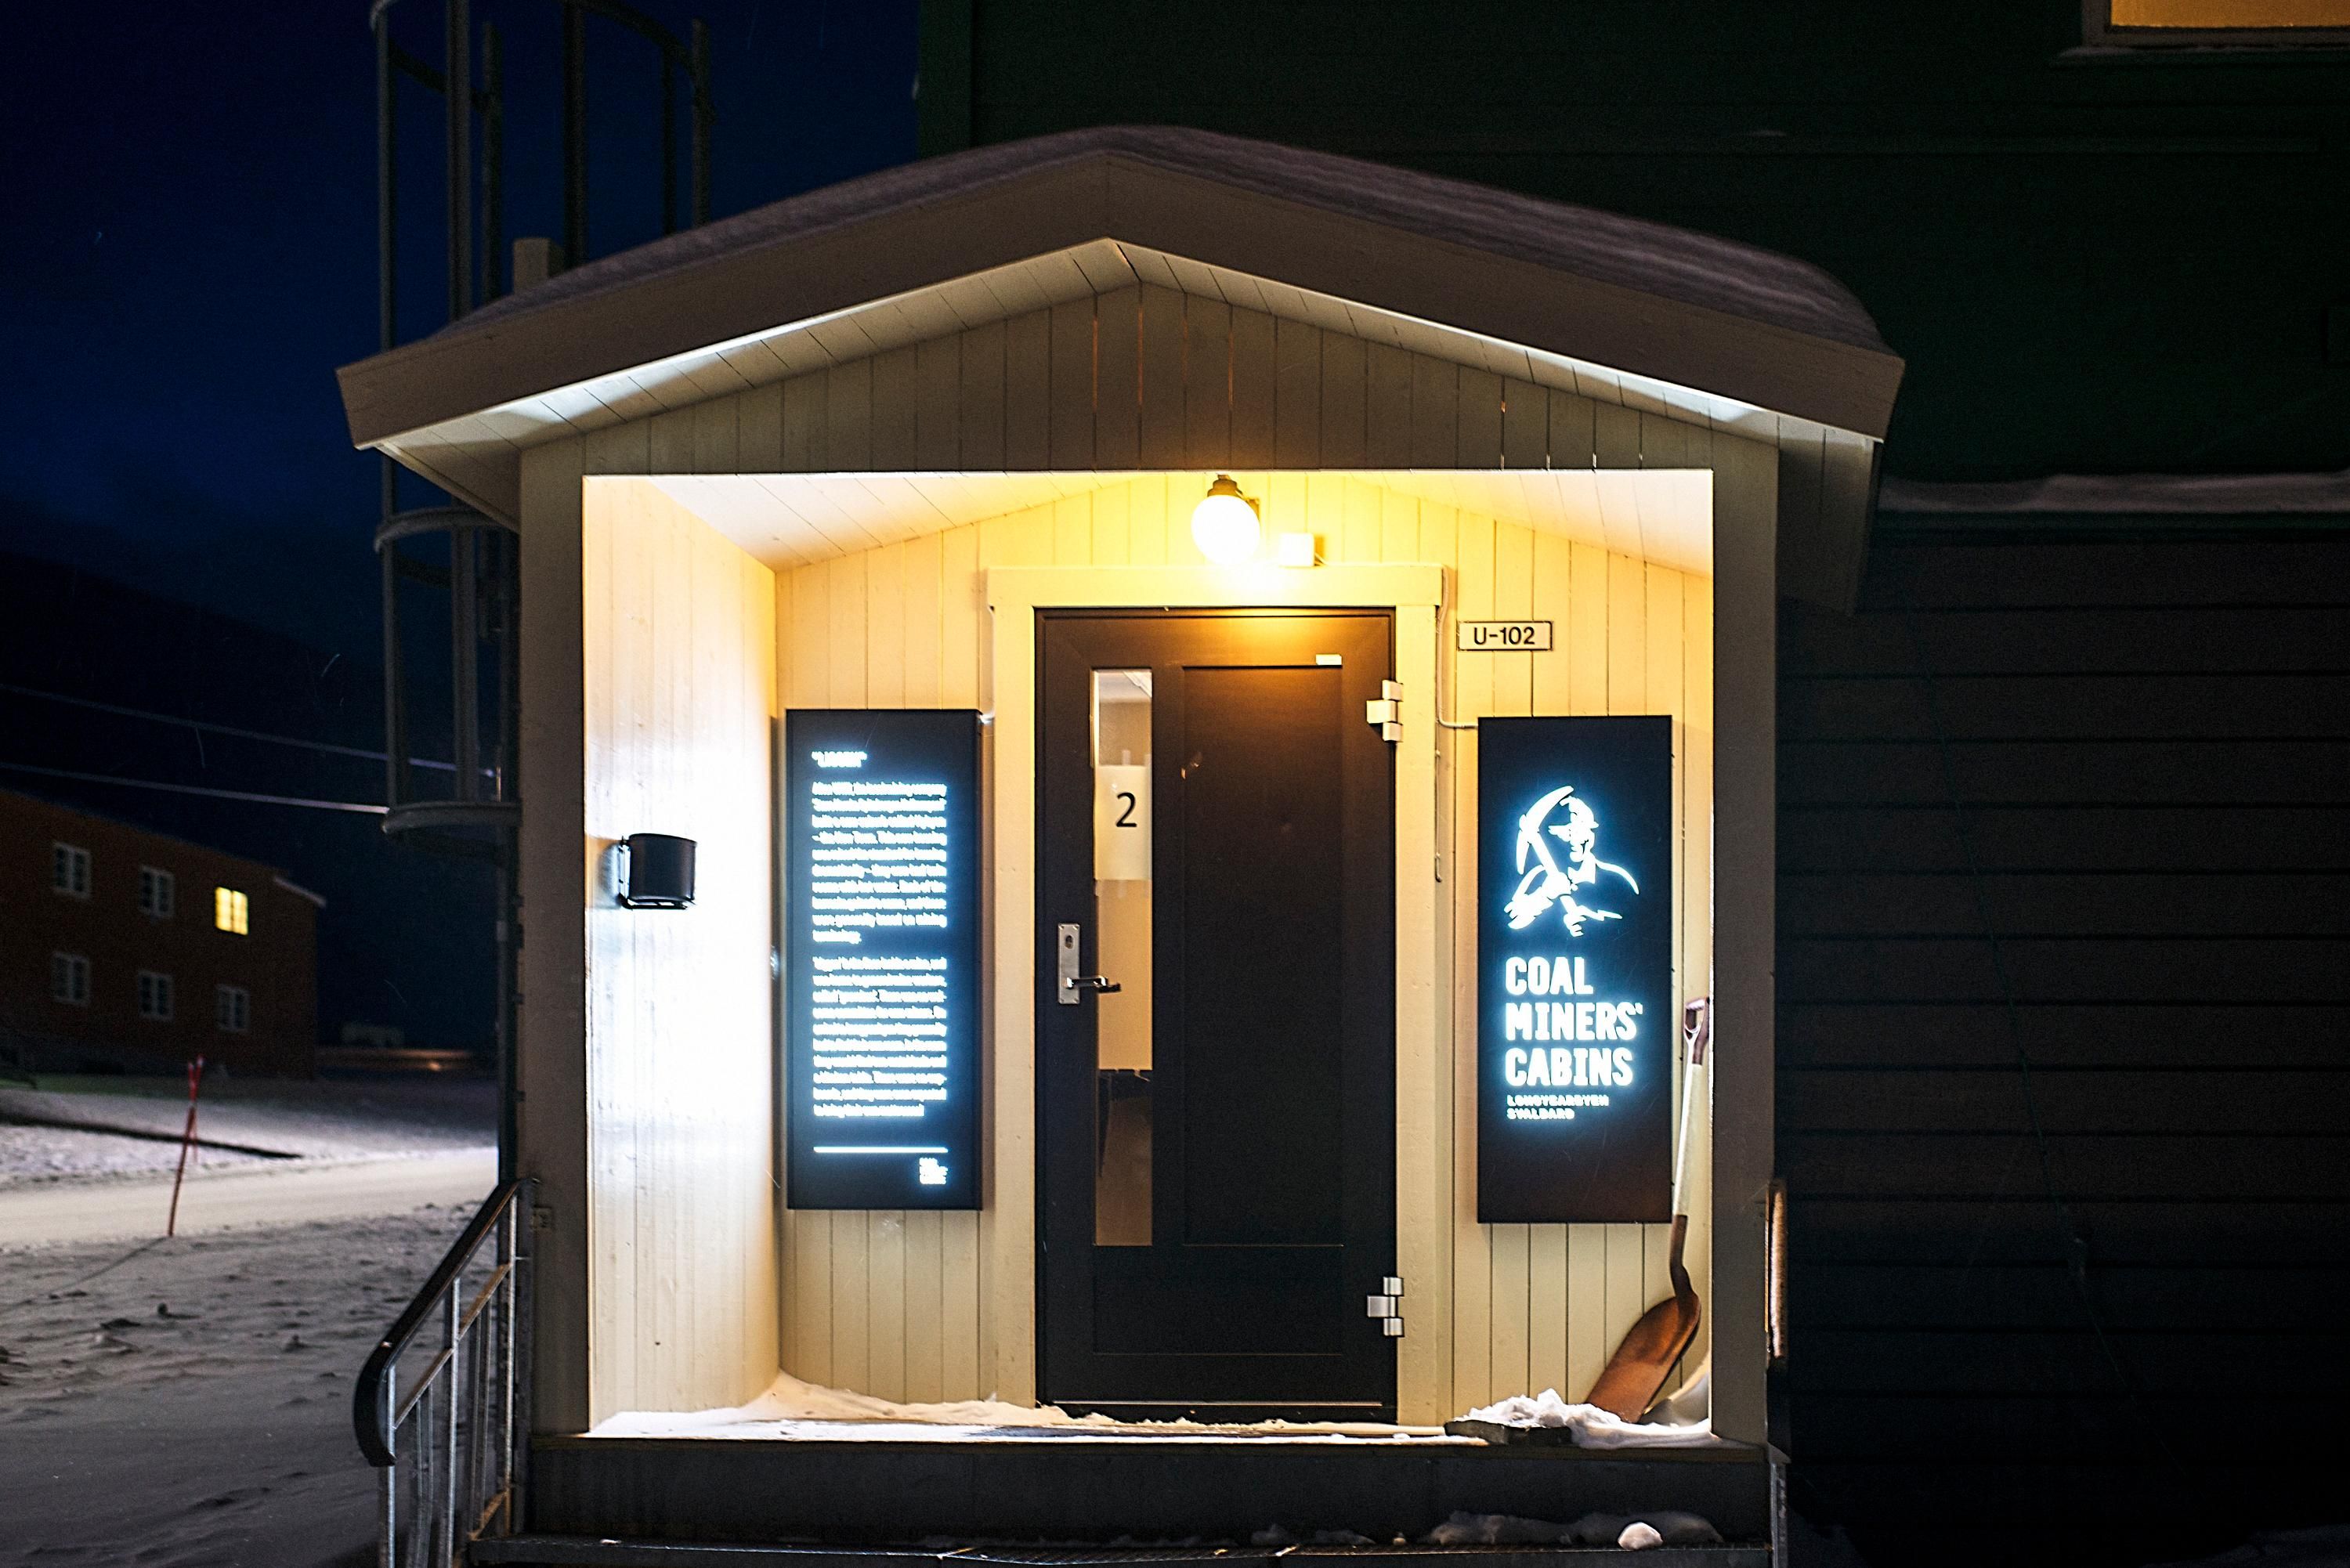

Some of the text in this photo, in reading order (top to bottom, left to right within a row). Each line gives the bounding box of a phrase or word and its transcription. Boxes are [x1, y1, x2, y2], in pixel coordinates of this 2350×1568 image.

[1473, 626, 1535, 645] U-102
[1115, 792, 1137, 828] 2
[1506, 956, 1594, 995] COAL
[1506, 1002, 1643, 1041] MINERS'
[1505, 1047, 1633, 1086] CABINS
